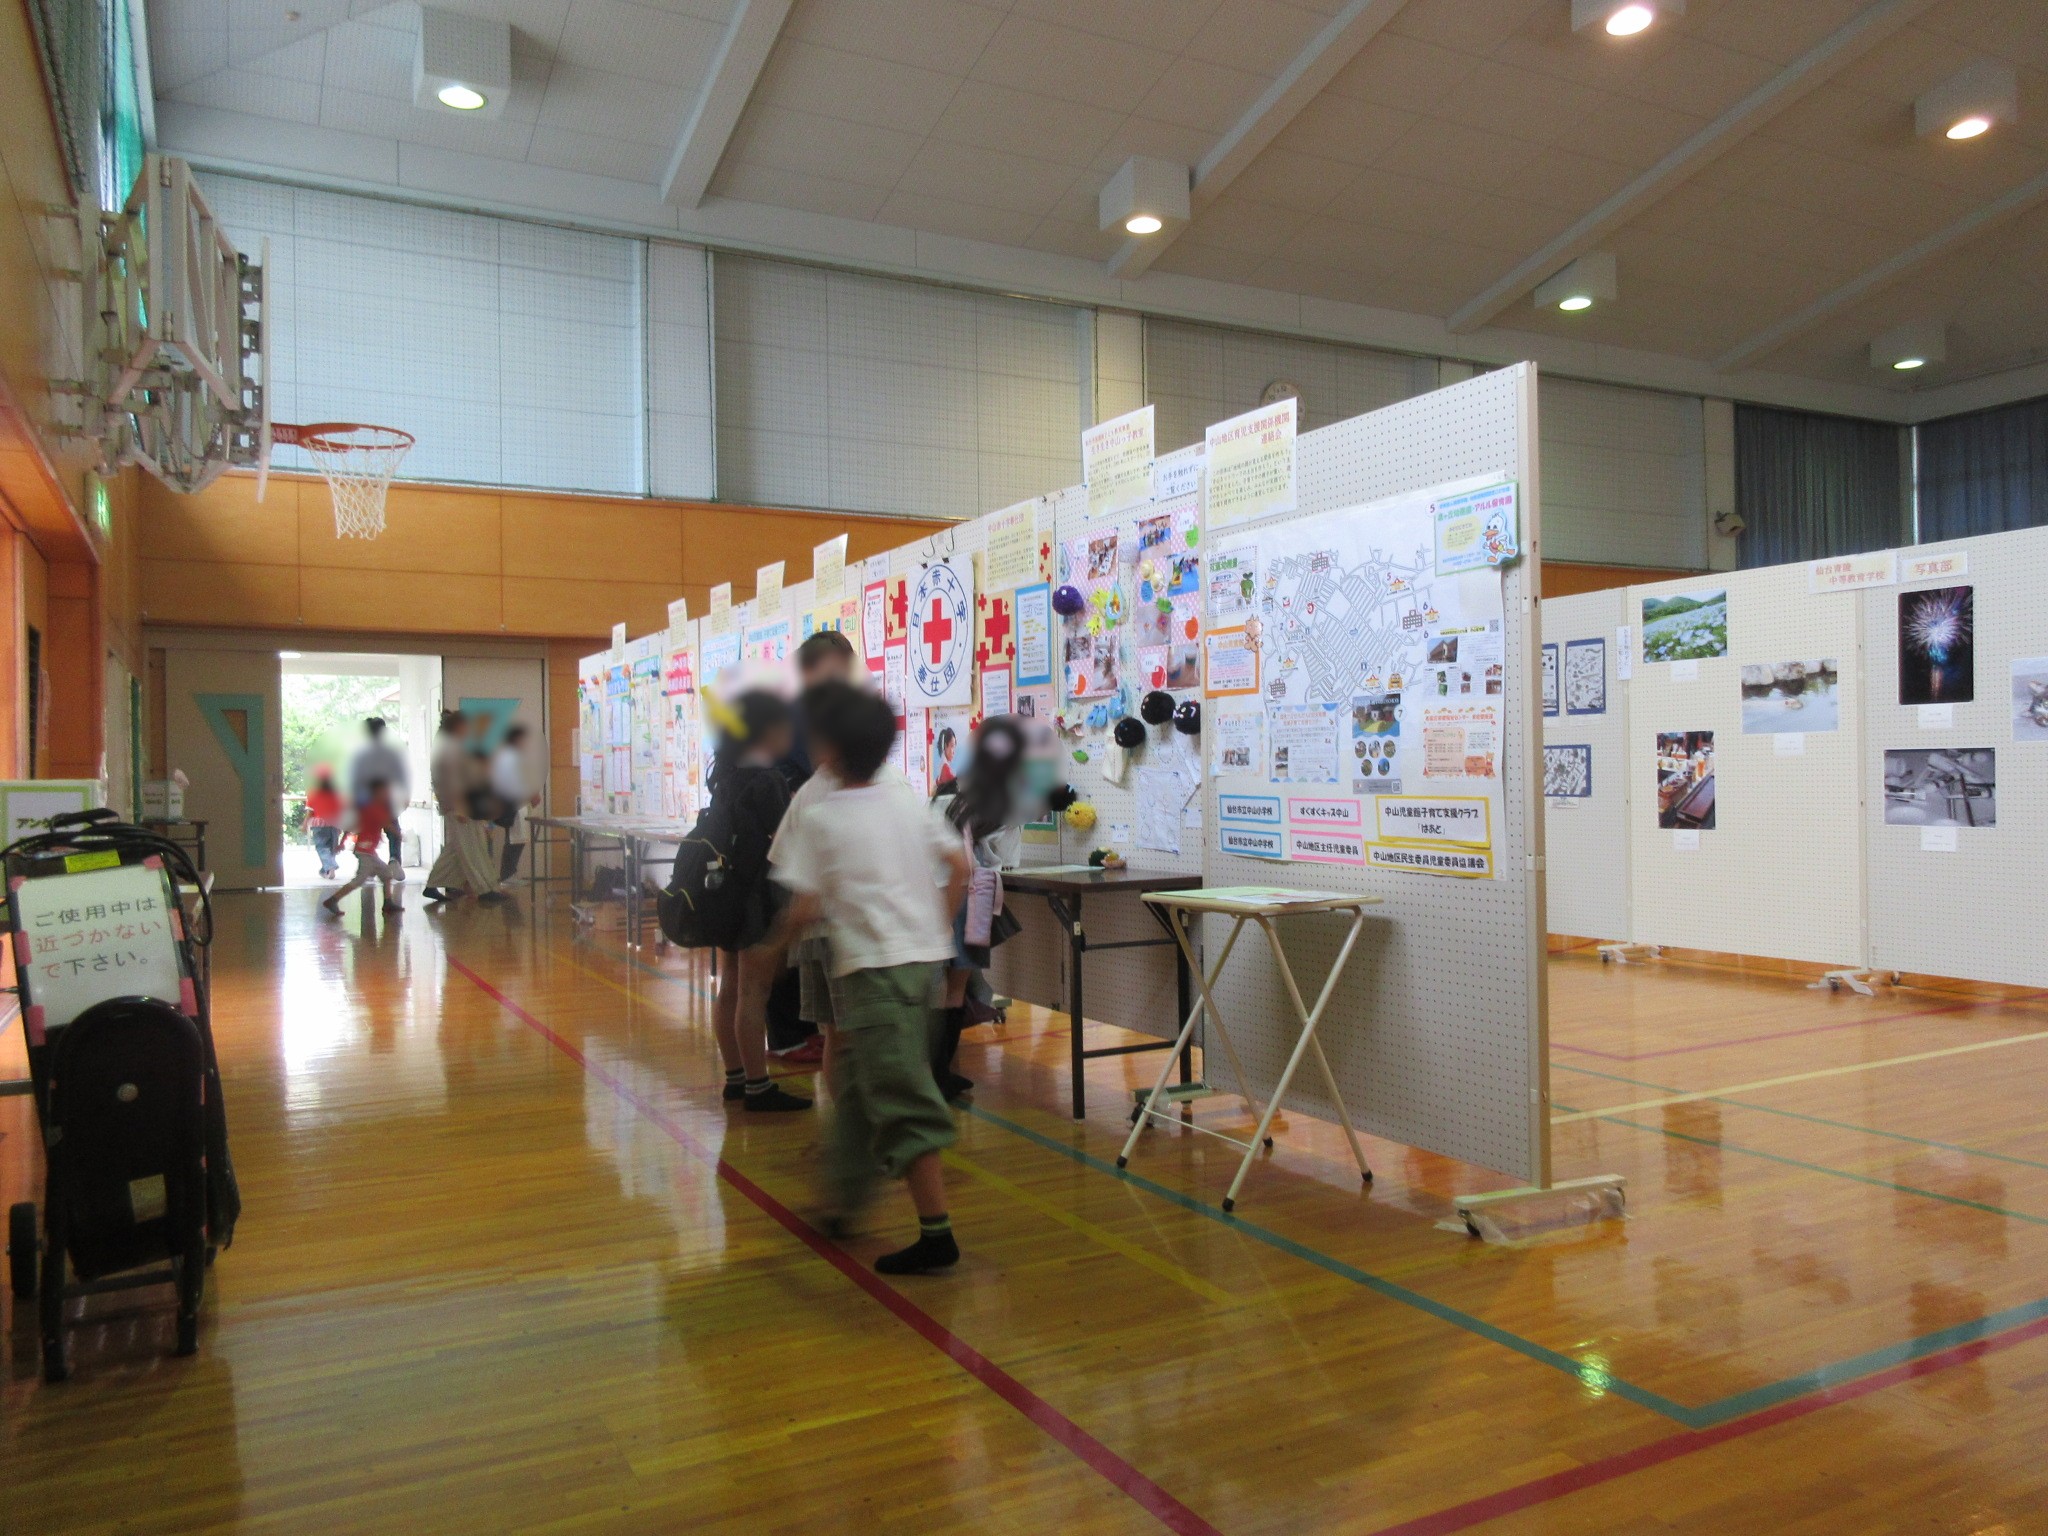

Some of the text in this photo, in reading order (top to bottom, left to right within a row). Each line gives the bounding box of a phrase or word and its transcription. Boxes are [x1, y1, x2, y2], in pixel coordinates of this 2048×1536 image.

[1914, 559, 1953, 576] 写真部
[1829, 570, 1886, 586] 中等教育学校
[1227, 805, 1273, 815] 仙台市立中山小学校
[1384, 806, 1479, 819] 中山児童館子育て支援クラブ
[1228, 835, 1274, 849] 仙台市立中山中学校
[1296, 840, 1359, 856] 中山地区主任児童委員
[1373, 851, 1485, 869] 中山地区民生委員児童委員協議会
[35, 897, 158, 928] ご使用中は
[36, 921, 162, 954] 近づかない
[41, 951, 150, 979] で下さい。
